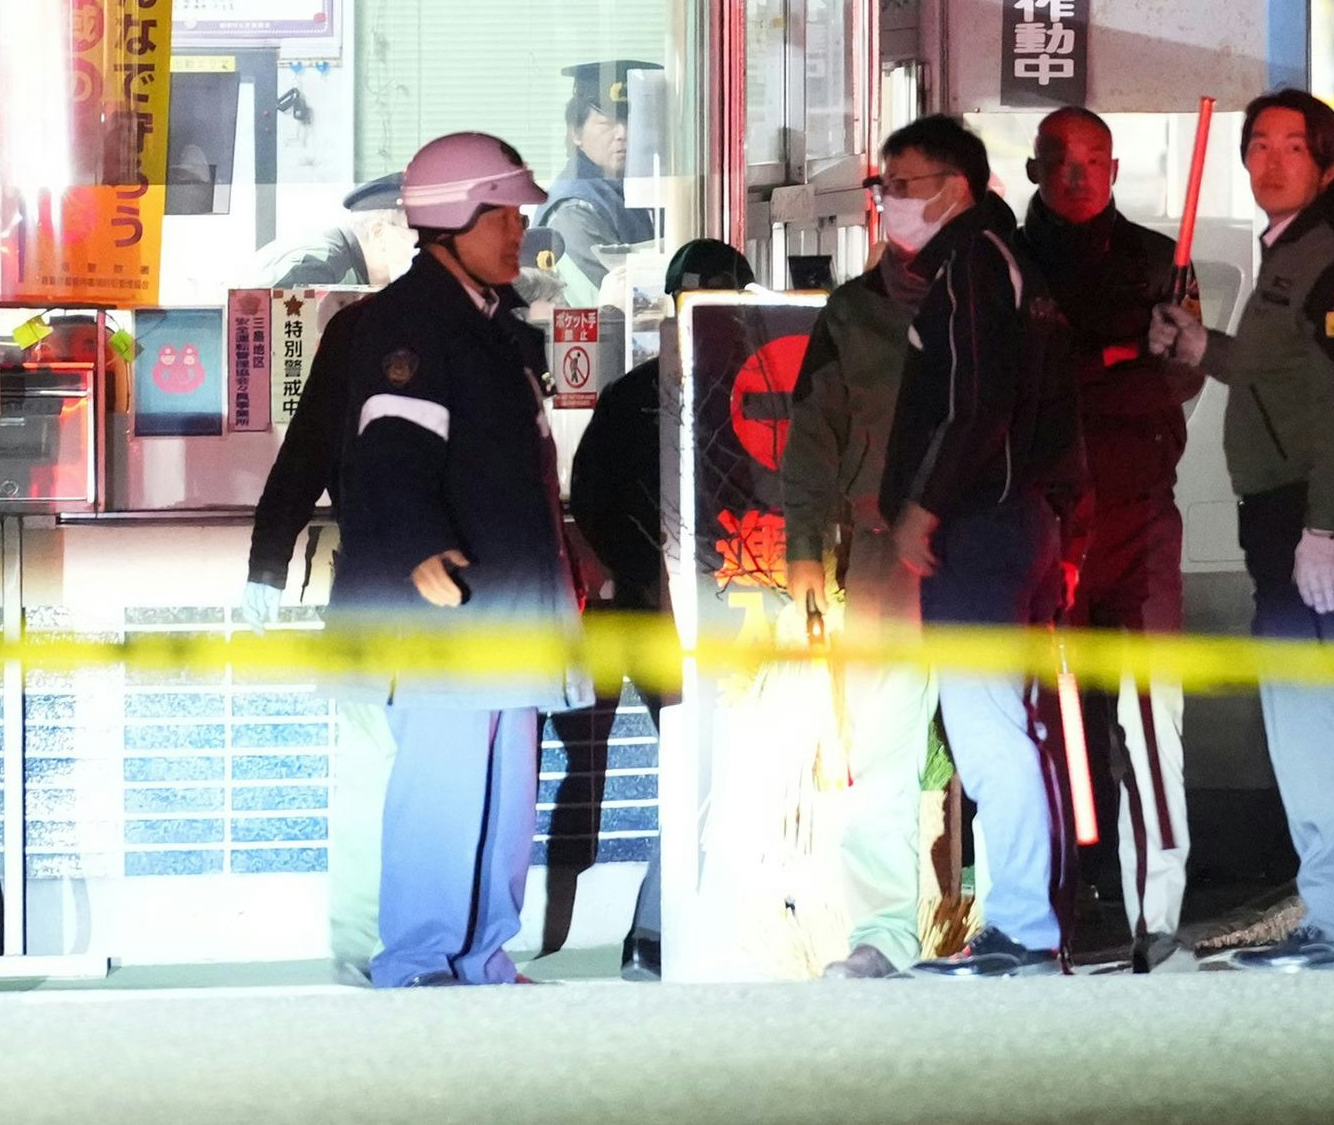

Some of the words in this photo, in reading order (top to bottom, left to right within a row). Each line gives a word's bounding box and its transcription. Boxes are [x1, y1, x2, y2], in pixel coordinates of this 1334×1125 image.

[282, 320, 303, 416] 特別警戒中
